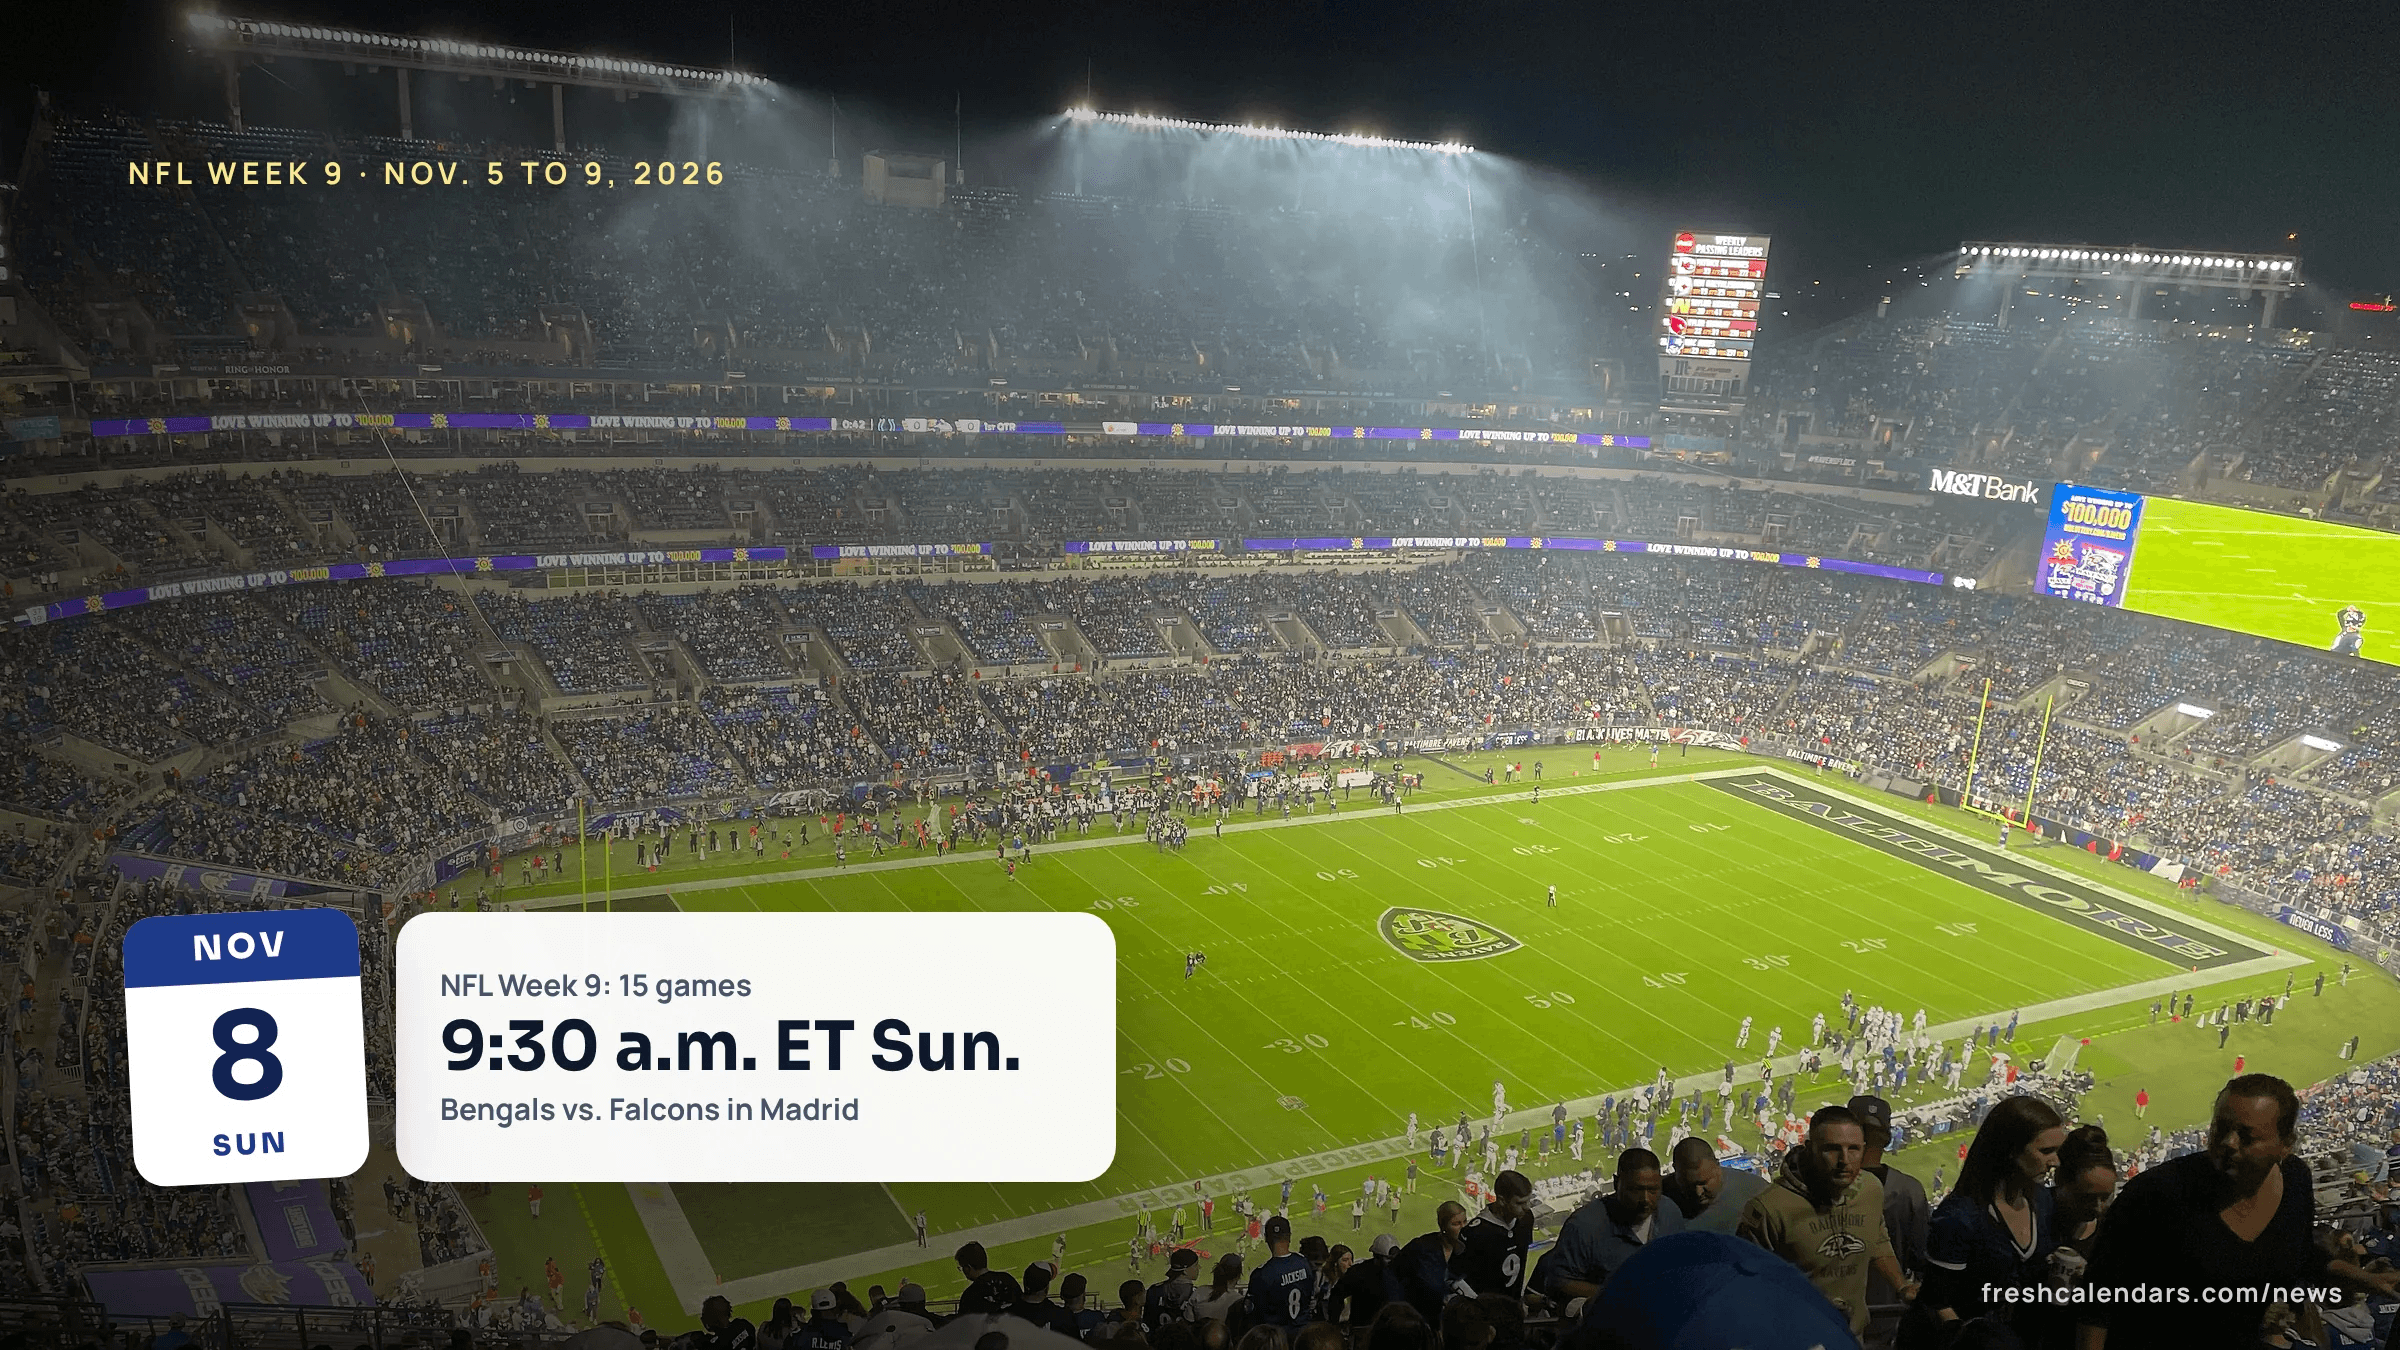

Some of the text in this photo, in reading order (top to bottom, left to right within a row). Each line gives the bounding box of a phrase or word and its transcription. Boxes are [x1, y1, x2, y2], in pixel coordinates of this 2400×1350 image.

[225, 365, 248, 374] RING
[254, 365, 290, 374] HONOR
[211, 415, 245, 429] LOVE
[250, 414, 310, 428] WINNING
[313, 414, 332, 427] UP
[334, 413, 352, 427] TO
[590, 416, 620, 428] LOVE
[622, 416, 675, 427] WINNING
[677, 416, 694, 428] UP
[696, 416, 711, 427] TO
[997, 422, 1016, 432] QTR
[1214, 425, 1236, 435] LOVE
[1238, 426, 1276, 436] WINNING
[1278, 426, 1291, 436] UP
[1292, 427, 1304, 436] TO
[1459, 429, 1481, 439] LOVE
[1482, 430, 1521, 441] WINNING
[1523, 431, 1536, 441] UP
[1537, 432, 1549, 441] TO
[1929, 468, 2040, 504] M&T Bank
[839, 546, 866, 557] LOVE
[867, 545, 916, 556] WINNING
[919, 544, 933, 555] UP
[934, 544, 948, 554] TO
[1088, 541, 1112, 551] LOVE
[1114, 540, 1157, 550] WINNING
[1159, 540, 1172, 550] UP
[1174, 540, 1186, 550] TO
[1392, 538, 1413, 547] LOVE
[1415, 538, 1453, 547] WINNING
[1455, 538, 1467, 547] UP
[1469, 538, 1480, 547] TO
[537, 555, 567, 567] LOVE
[571, 553, 626, 566] WINNING
[629, 552, 645, 564] UP
[647, 551, 664, 563] TO
[1647, 543, 1672, 554] LOVE
[1674, 545, 1717, 557] WINNING
[1719, 548, 1733, 558] UP
[1735, 549, 1749, 560] TO
[150, 585, 181, 600] LOVE
[182, 578, 244, 597] WINNING
[247, 574, 267, 587] UP
[269, 571, 287, 584] TO
[1606, 728, 1633, 741] LIVES
[1729, 779, 2228, 960] BALTIMORE
[1934, 923, 1978, 936] 10
[2289, 914, 2314, 932] NEVER
[1422, 941, 1511, 959] RAVENS
[1840, 938, 1887, 954] 20
[1742, 954, 1790, 970] 30
[1643, 972, 1686, 988] 40
[1524, 991, 1575, 1009] 50
[1410, 1011, 1457, 1030] 40
[1274, 1033, 1329, 1054] 30
[1134, 1057, 1191, 1080] 20
[1281, 1268, 1307, 1287] JACKSON
[1502, 1253, 1521, 1288] 9
[1288, 1288, 1301, 1320] 8
